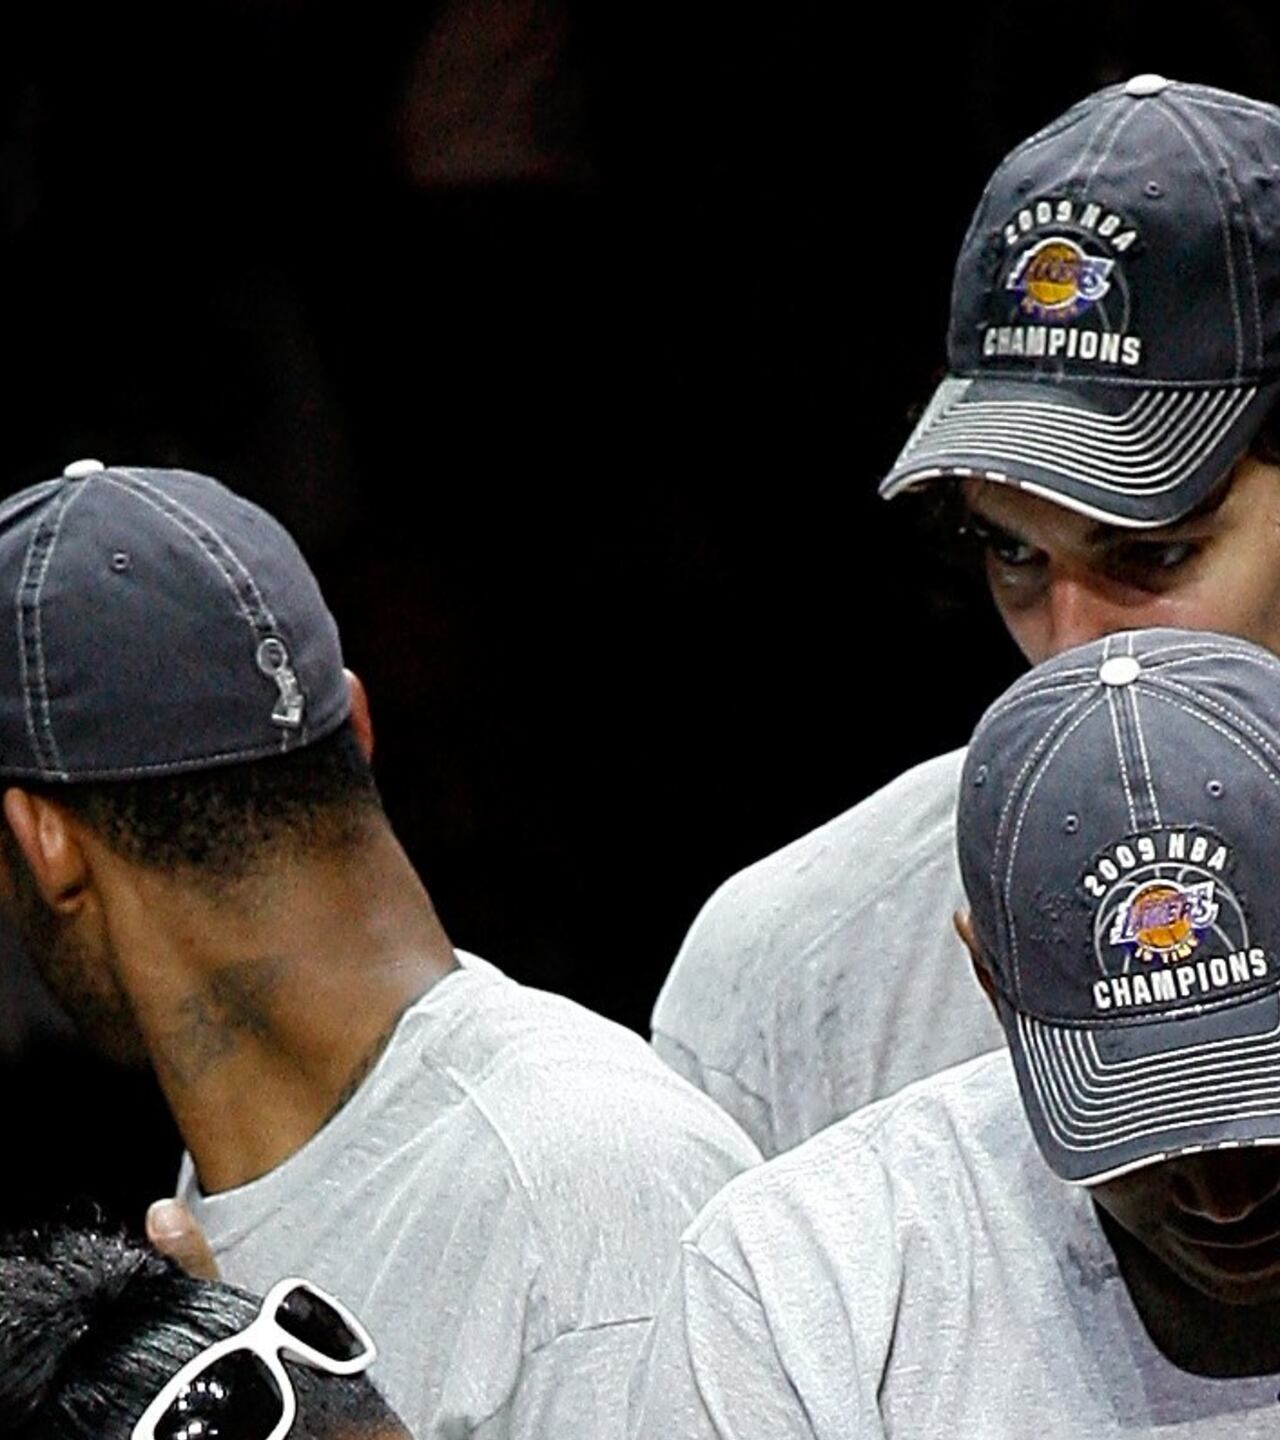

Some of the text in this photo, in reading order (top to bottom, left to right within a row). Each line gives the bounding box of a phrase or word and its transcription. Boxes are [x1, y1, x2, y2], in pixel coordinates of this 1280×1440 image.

[983, 325, 1141, 366] CHAMPIONS
[1084, 836, 1156, 897] 2009
[1169, 833, 1227, 871] NBA
[1092, 948, 1268, 1009] CHAMPIONS
